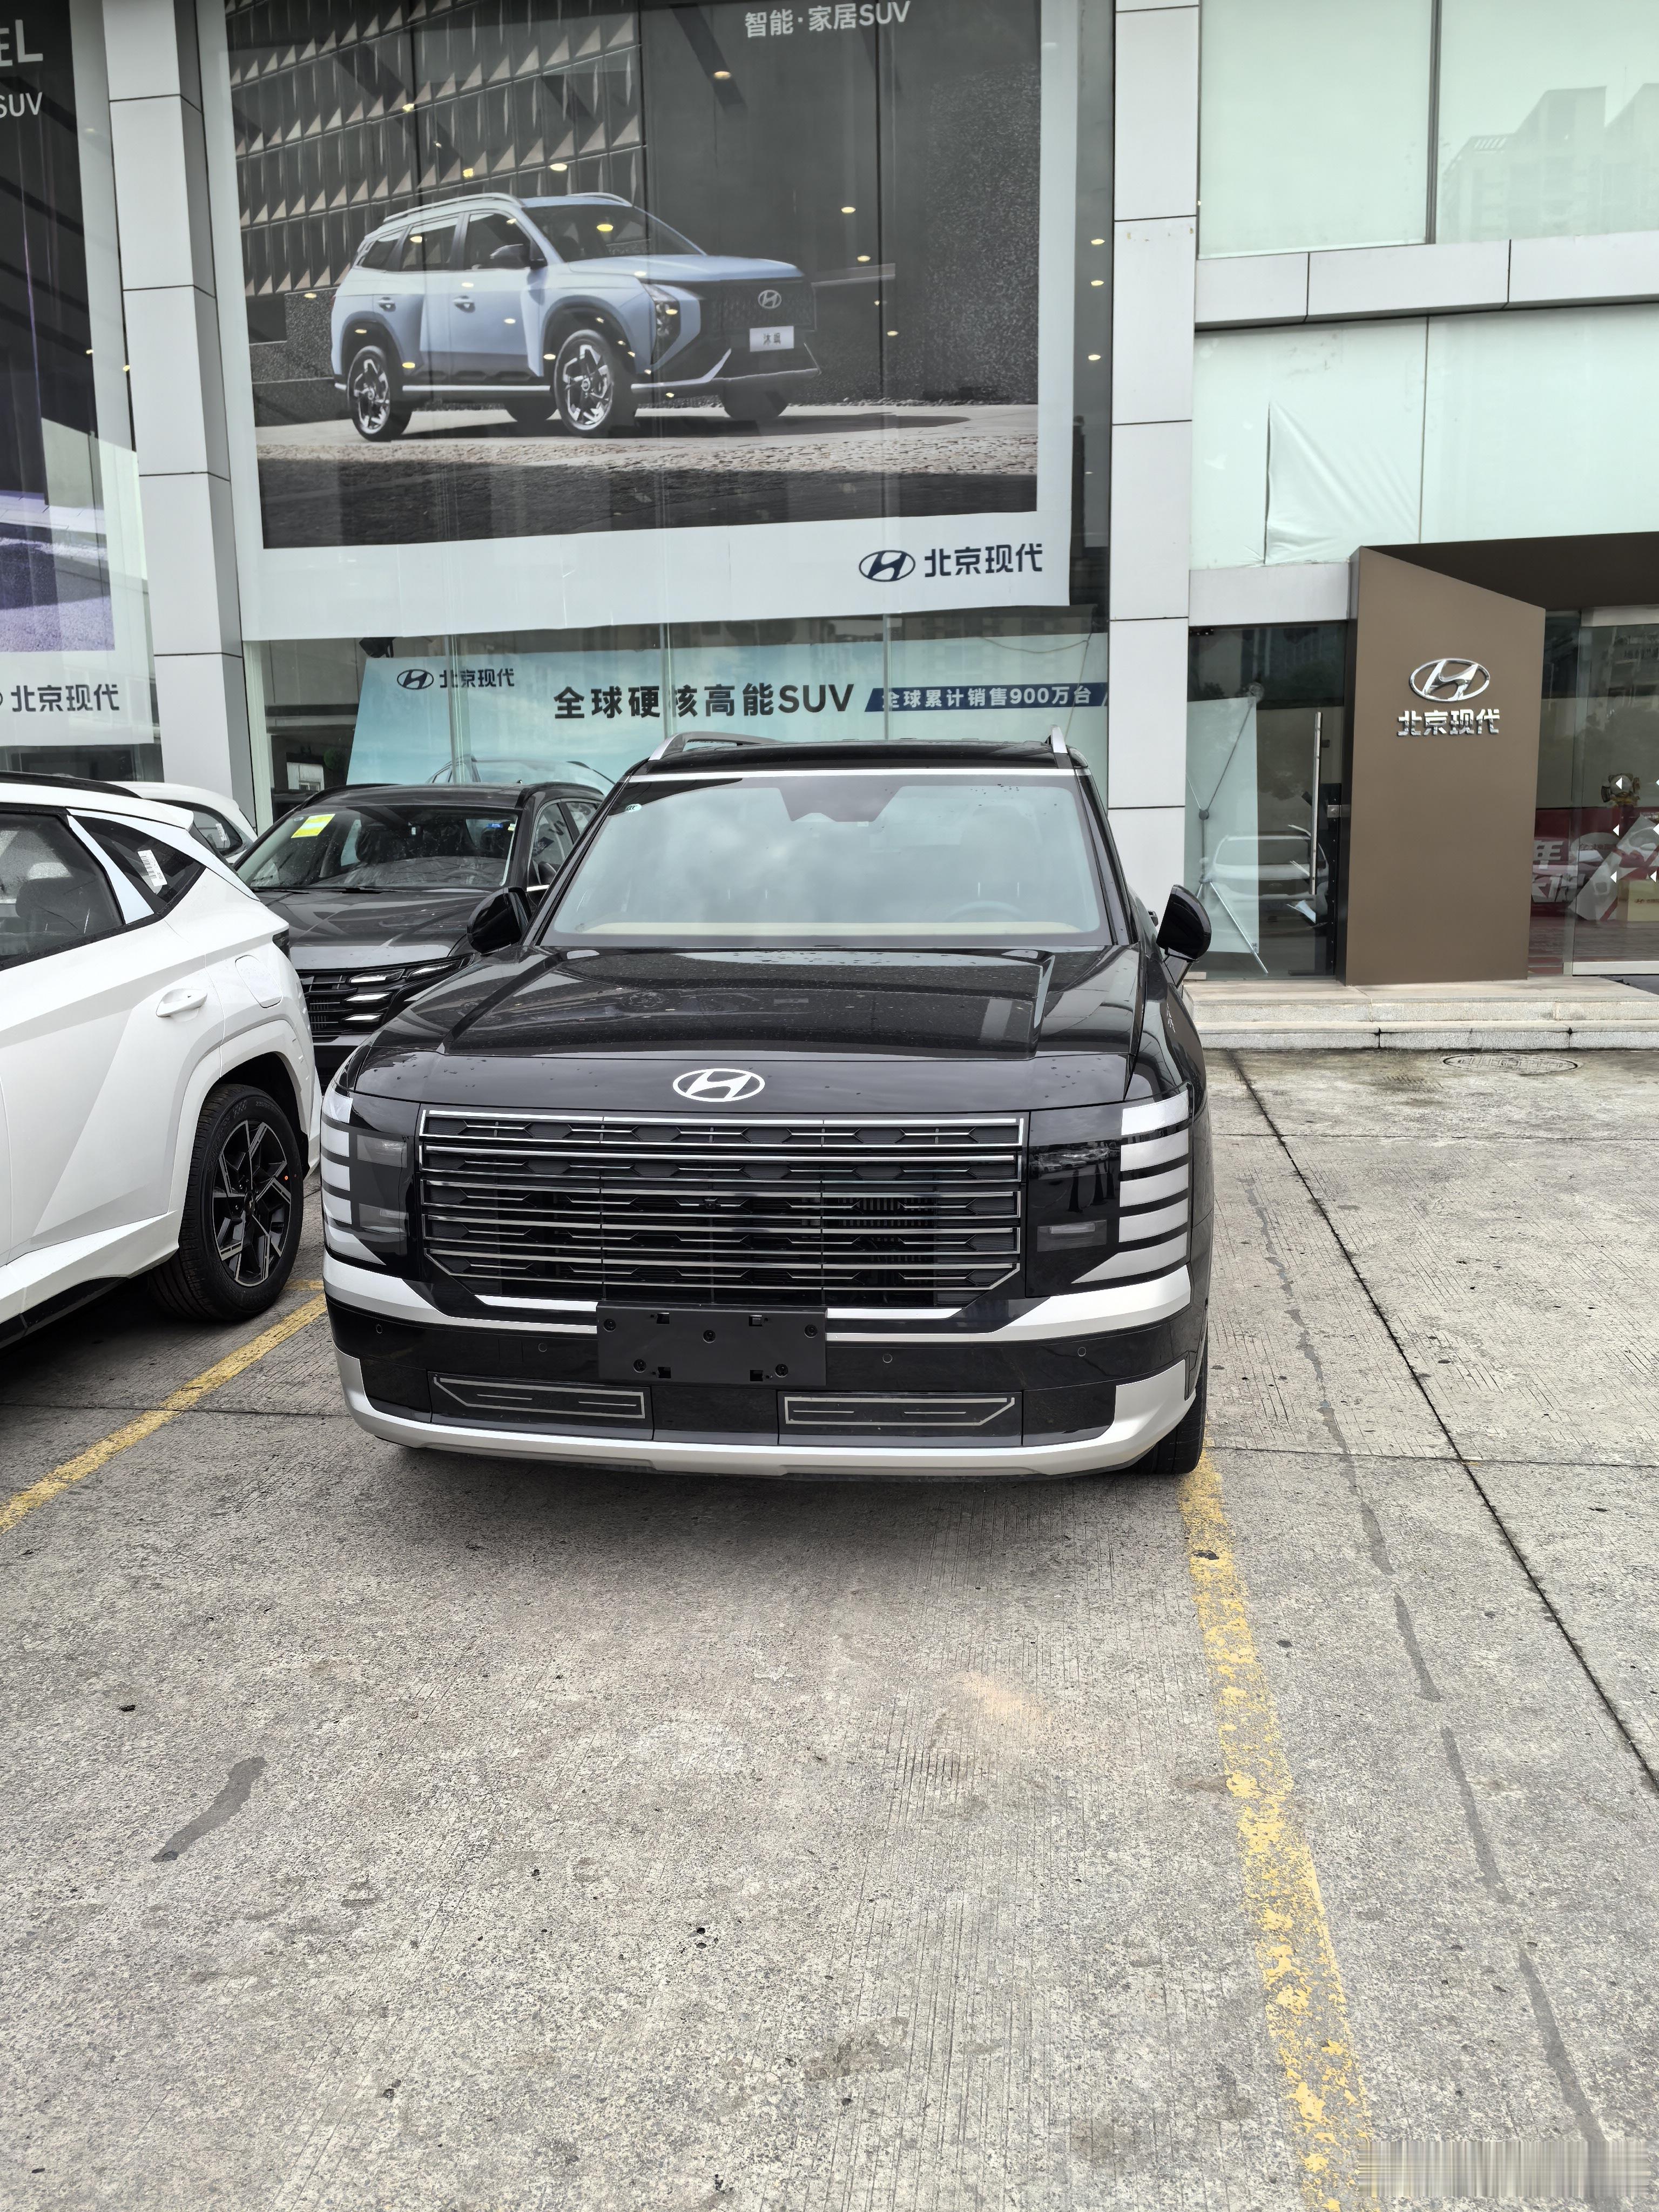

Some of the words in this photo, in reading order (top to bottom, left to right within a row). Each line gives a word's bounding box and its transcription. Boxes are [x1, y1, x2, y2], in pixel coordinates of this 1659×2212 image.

[745, 1, 911, 38] 智能·家居SUV
[924, 543, 1043, 577] 北京现代
[11, 684, 120, 712] 北京现代
[1397, 709, 1500, 736] 北京现代
